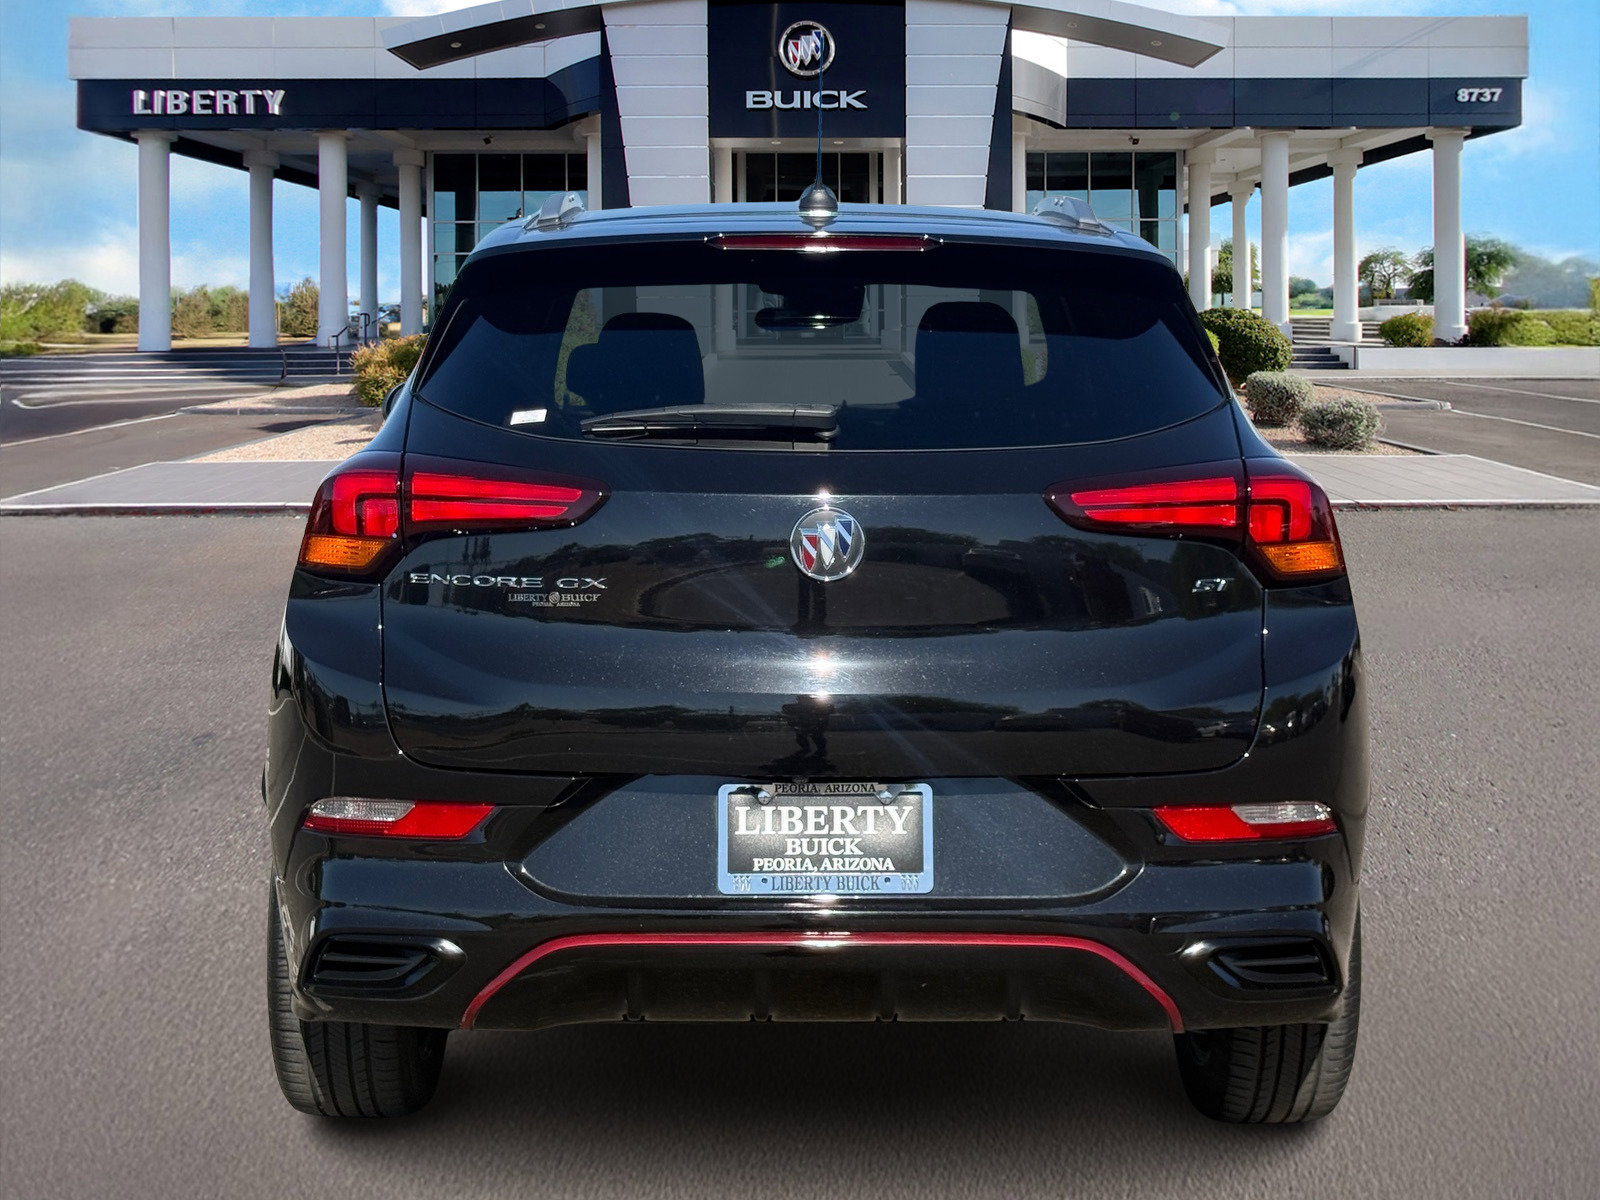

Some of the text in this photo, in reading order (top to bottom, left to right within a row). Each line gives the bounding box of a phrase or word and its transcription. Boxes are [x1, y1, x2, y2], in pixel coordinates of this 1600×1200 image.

[132, 89, 285, 115] LIBERTY
[745, 90, 868, 109] BUICK
[1456, 88, 1503, 102] 8737
[409, 573, 608, 589] ENCORE GX
[1191, 578, 1234, 592] ST
[508, 593, 602, 602] LIBERTY BUICK
[825, 783, 876, 793] ARIZONA
[734, 805, 914, 835] LIBERTY
[784, 837, 864, 856] BUICK
[752, 857, 896, 873] PEORIA, ARIZONA
[771, 875, 881, 891] LIBERTY BUICK
